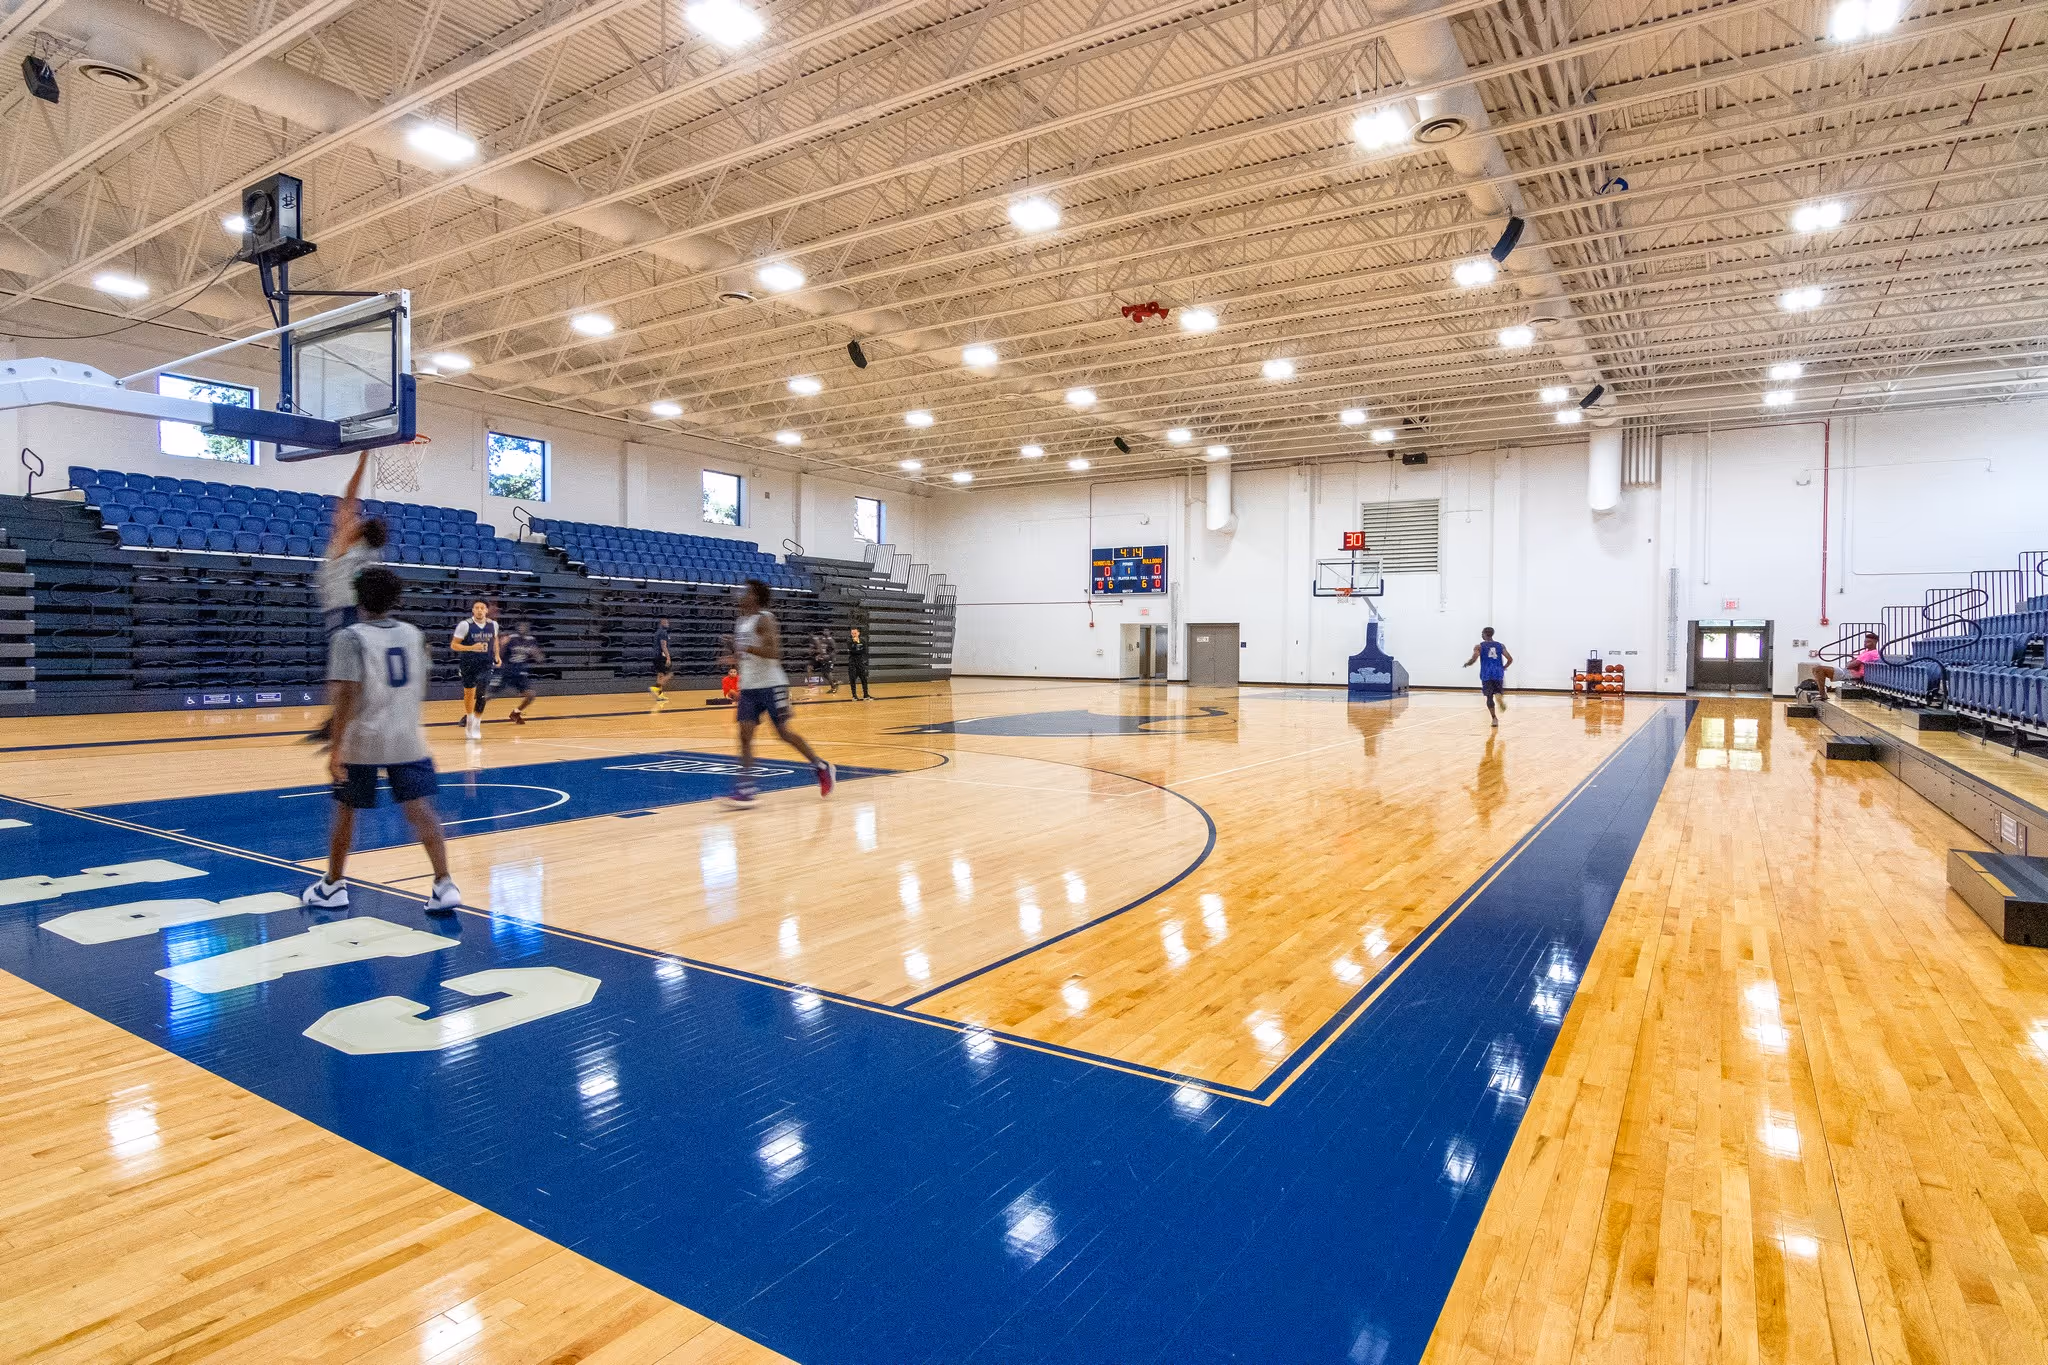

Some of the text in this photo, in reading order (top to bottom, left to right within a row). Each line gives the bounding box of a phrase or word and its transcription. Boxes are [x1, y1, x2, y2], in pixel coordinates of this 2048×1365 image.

[1346, 533, 1361, 546] 30
[1120, 548, 1142, 557] 4:14
[1104, 566, 1111, 576] 0
[1154, 564, 1161, 575] 0
[1098, 581, 1104, 589] 0
[1108, 580, 1114, 589] 6
[1141, 579, 1147, 588] 6
[1155, 579, 1161, 588] 0
[1488, 646, 1498, 659] 4
[386, 647, 408, 688] 0
